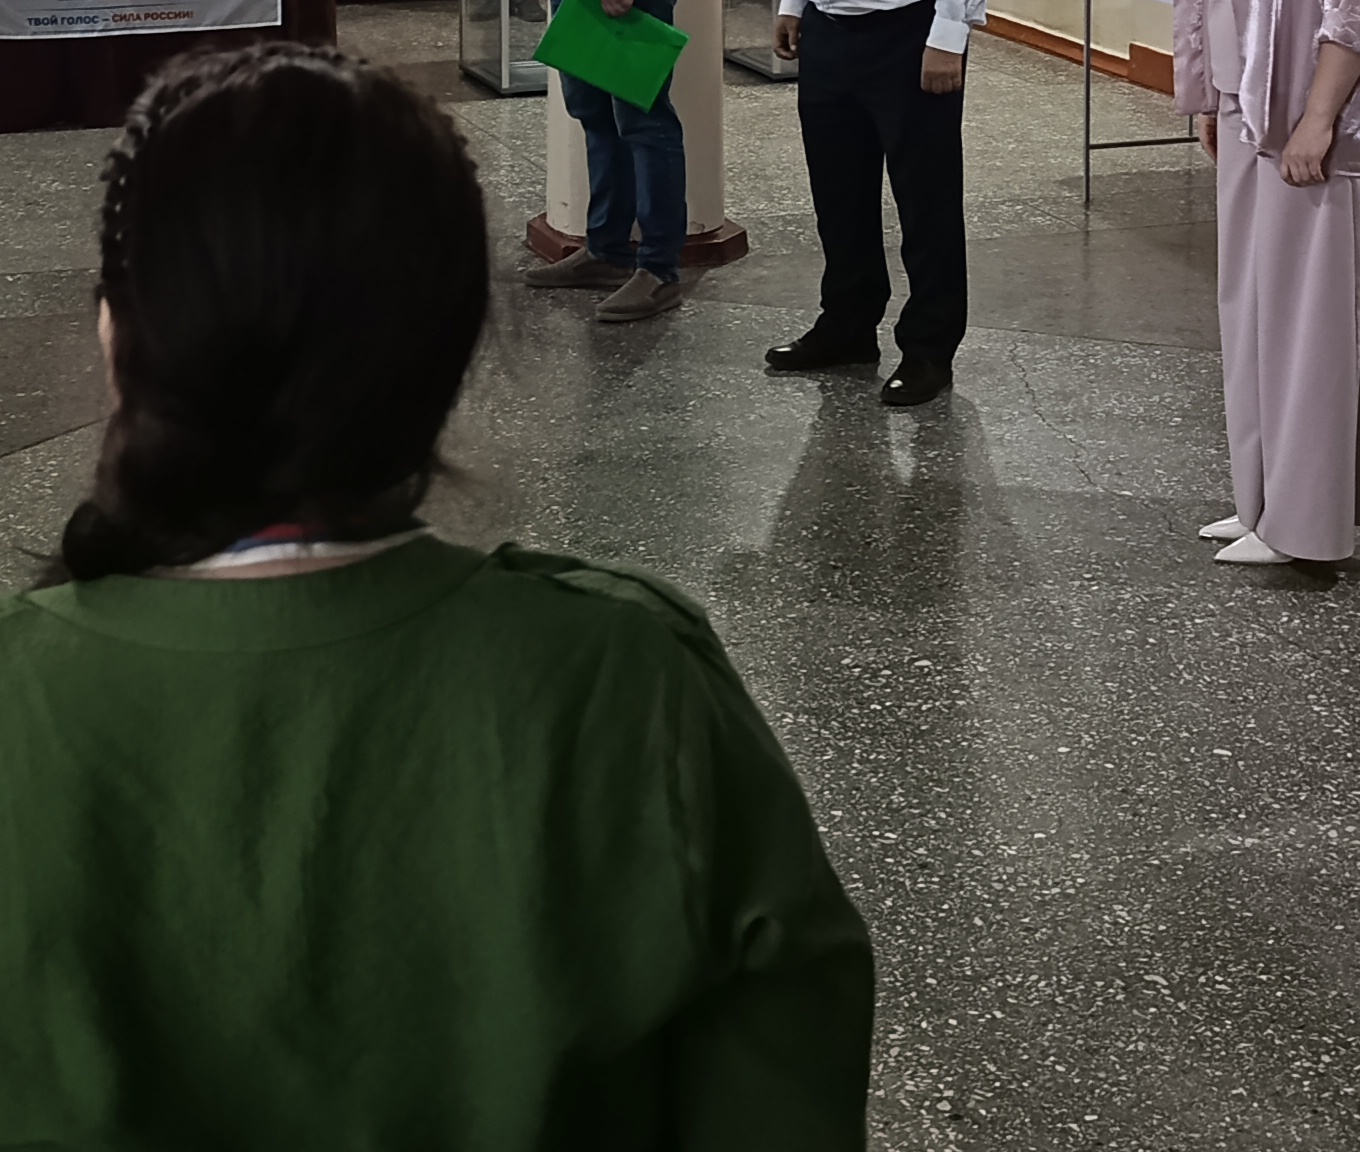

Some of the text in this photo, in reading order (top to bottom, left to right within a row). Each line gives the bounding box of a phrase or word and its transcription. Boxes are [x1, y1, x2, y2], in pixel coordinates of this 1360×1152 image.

[27, 15, 58, 27] ТВОЙ
[61, 15, 100, 25] ГОЛОС
[112, 13, 143, 23] СИЛА
[144, 10, 193, 21] РОССИИ!
